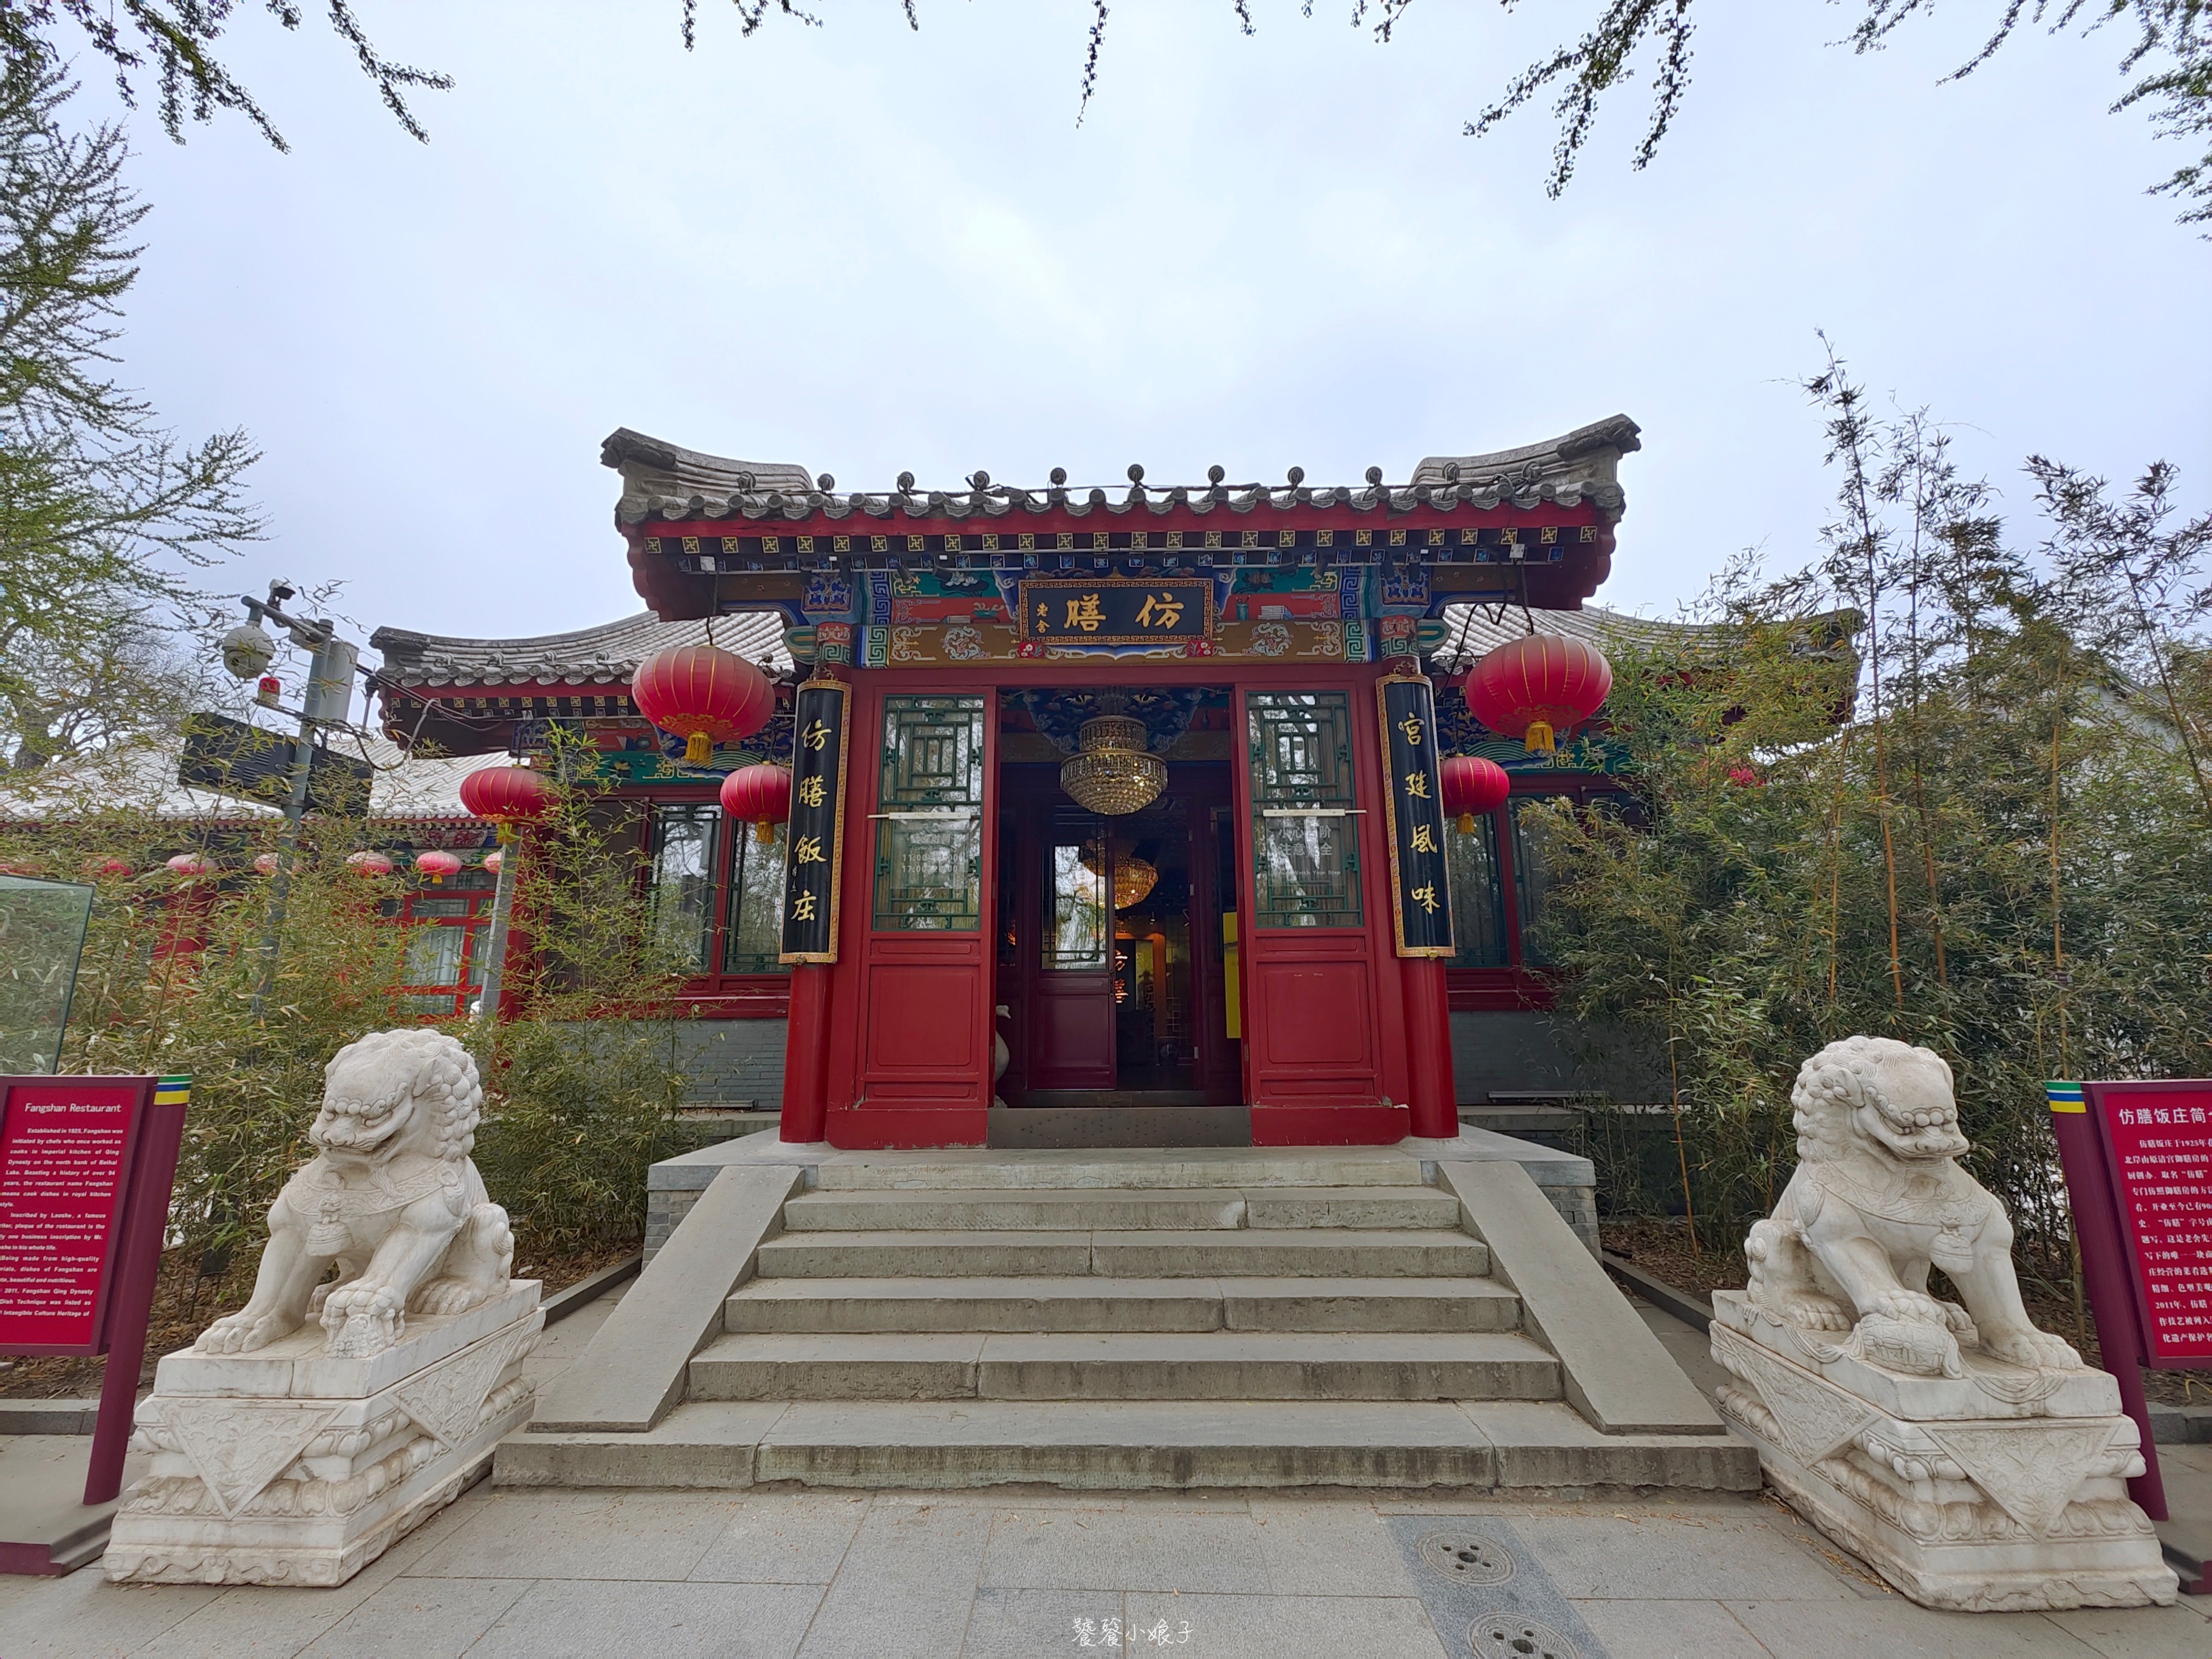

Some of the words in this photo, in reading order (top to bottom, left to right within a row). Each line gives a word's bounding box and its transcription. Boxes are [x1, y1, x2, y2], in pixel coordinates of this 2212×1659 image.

[1064, 592, 1184, 632] 仿膳
[1035, 602, 1050, 634] 老舍
[1278, 842, 1333, 856] 注意全
[24, 1103, 67, 1113] Fangshan
[69, 1103, 122, 1112] Restaurant
[2119, 1107, 2212, 1125] 仿膳饭庄简
[2136, 1202, 2212, 1212] 肴，开业至今已有90
[2141, 1234, 2212, 1244] 题写，这是老舍先
[2155, 1299, 2212, 1309] 2011年，仿膳
[2159, 1316, 2212, 1326] 作技艺被列入
